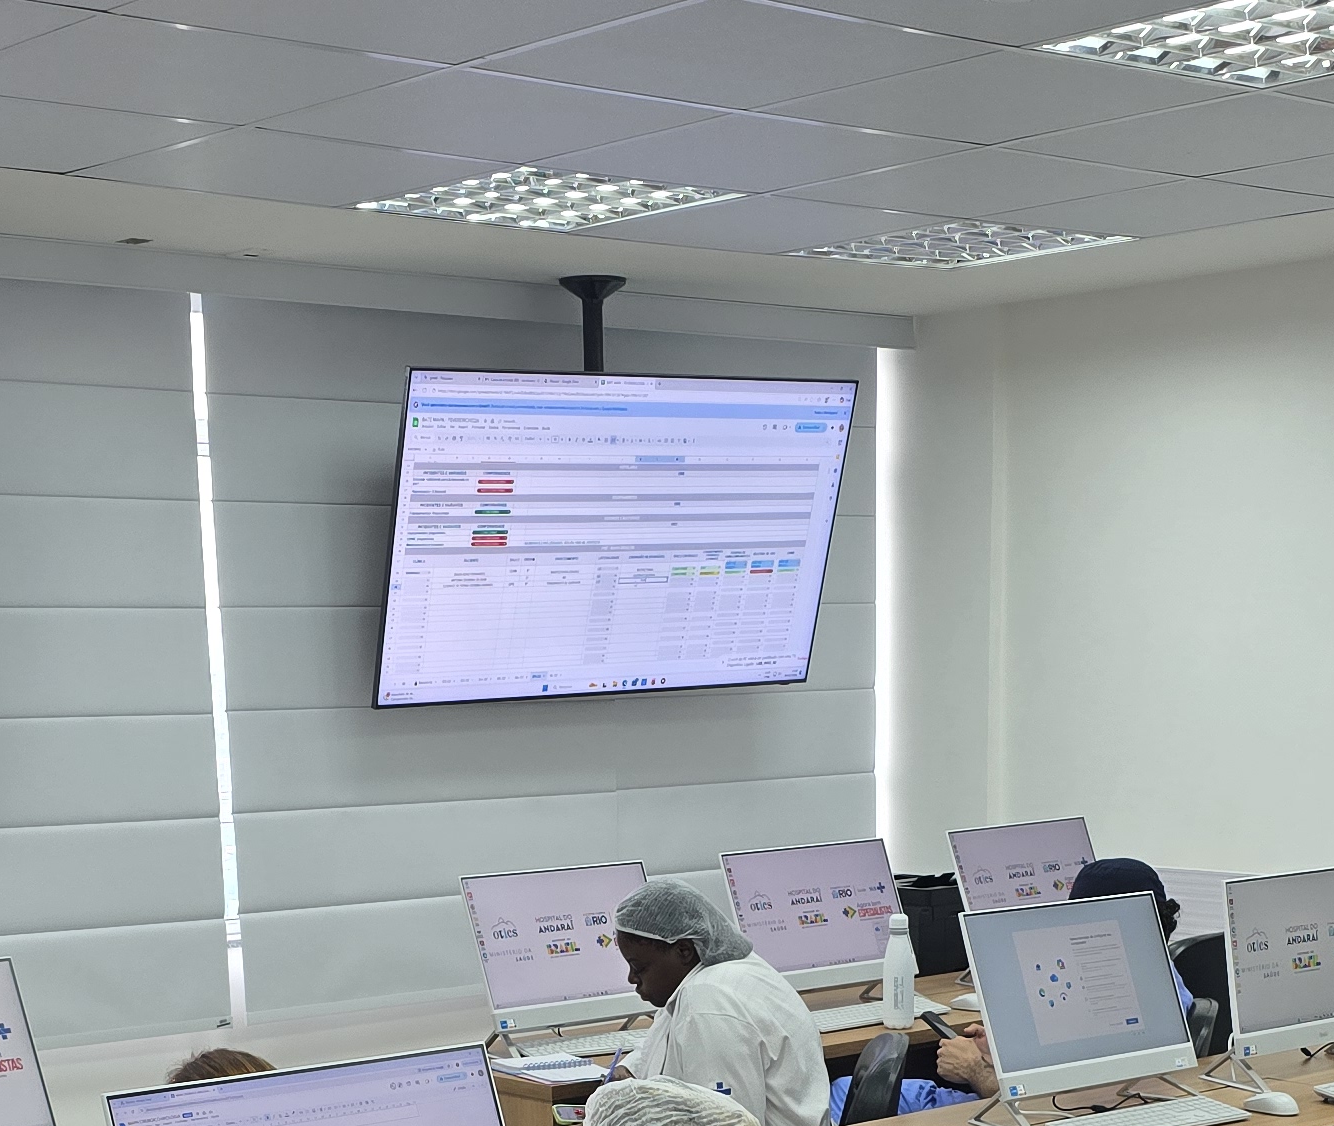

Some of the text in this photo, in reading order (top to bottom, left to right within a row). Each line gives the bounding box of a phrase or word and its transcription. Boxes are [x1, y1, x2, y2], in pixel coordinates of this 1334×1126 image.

[838, 888, 852, 898] RIO
[592, 915, 607, 925] RIO
[539, 920, 574, 934] ANDARAÍ
[1287, 930, 1318, 945] ANDARAÍ
